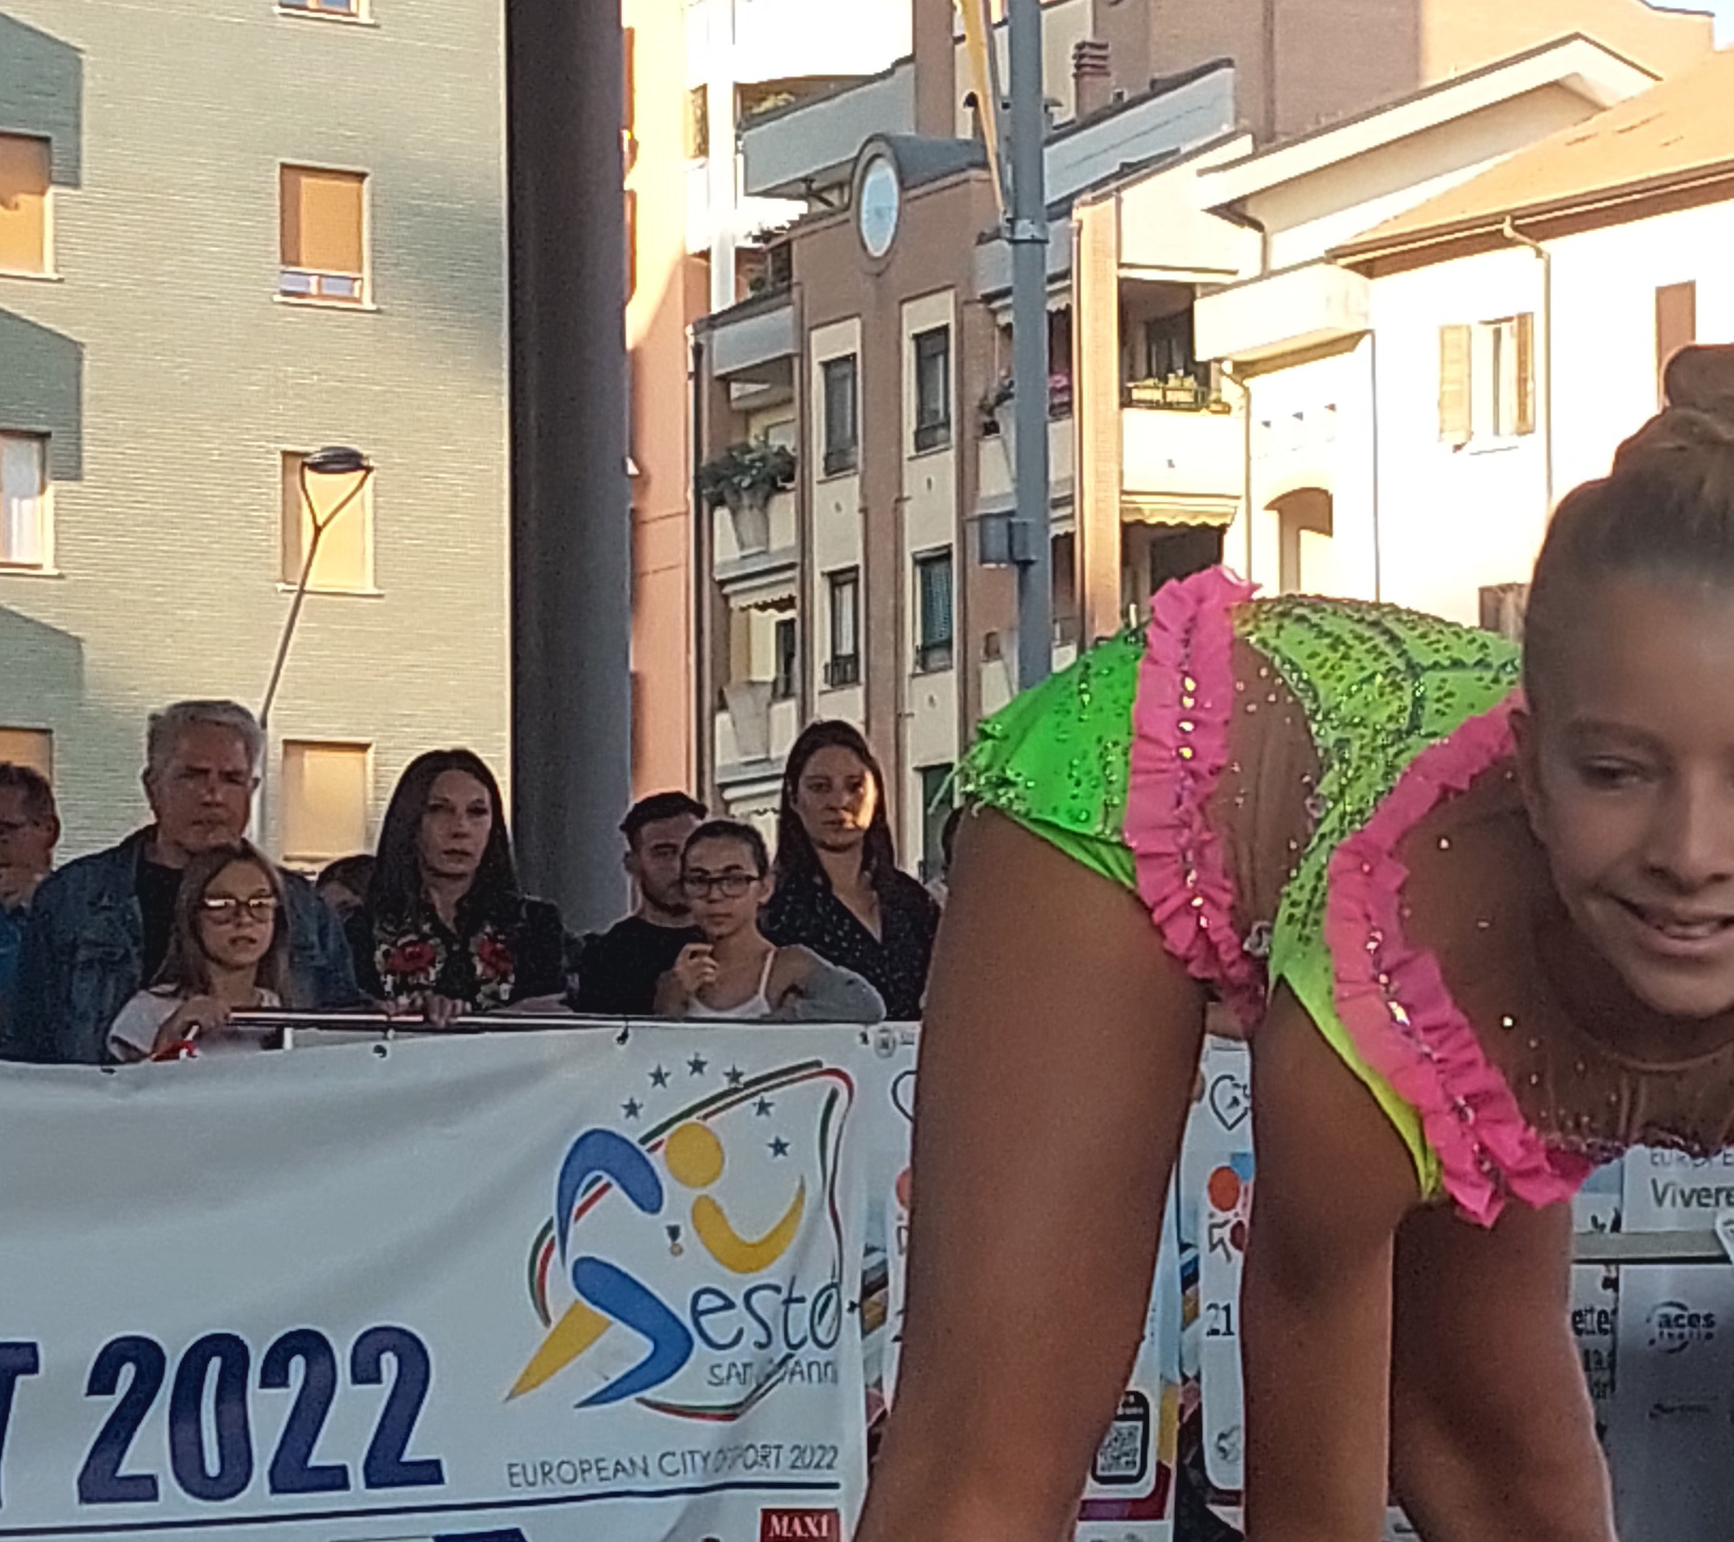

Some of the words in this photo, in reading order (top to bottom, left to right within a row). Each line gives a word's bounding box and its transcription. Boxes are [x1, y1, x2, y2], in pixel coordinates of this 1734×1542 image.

[1206, 1303, 1236, 1337] 21
[78, 1325, 446, 1506] 2022
[507, 1454, 650, 1488] EUROPEAN
[658, 1450, 711, 1477] CITY
[789, 1443, 839, 1470] 2022
[769, 1514, 830, 1537] MAXI
